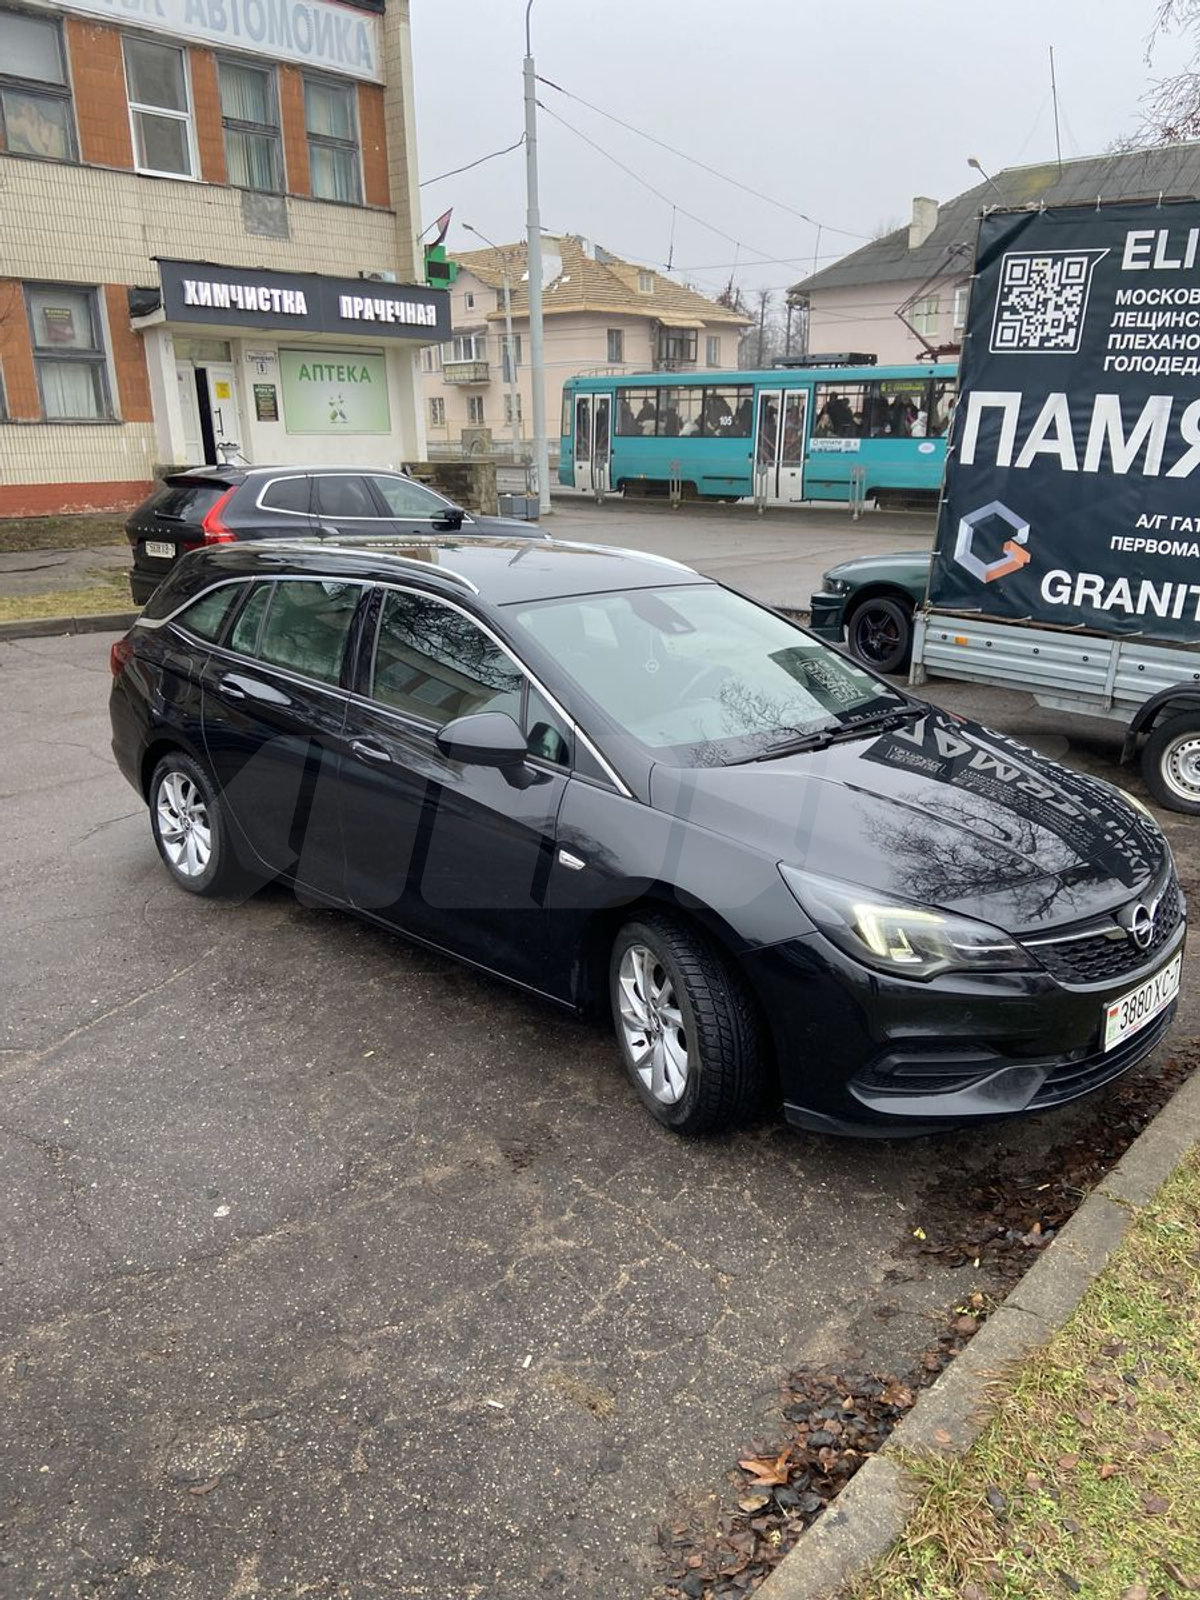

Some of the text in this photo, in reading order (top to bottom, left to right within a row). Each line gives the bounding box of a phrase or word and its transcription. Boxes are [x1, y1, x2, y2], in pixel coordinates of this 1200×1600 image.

[1121, 228, 1200, 270] ELI
[182, 280, 437, 327] ХИМЧИСТКА ПРАЧЕЧНАЯ
[1115, 288, 1200, 305] МОСКОВ
[1107, 333, 1200, 350] ПЛЕХАНО
[299, 363, 372, 383] АПТЕКА
[1135, 513, 1168, 529] А/Г
[1110, 535, 1200, 558] ПЕРВОМА
